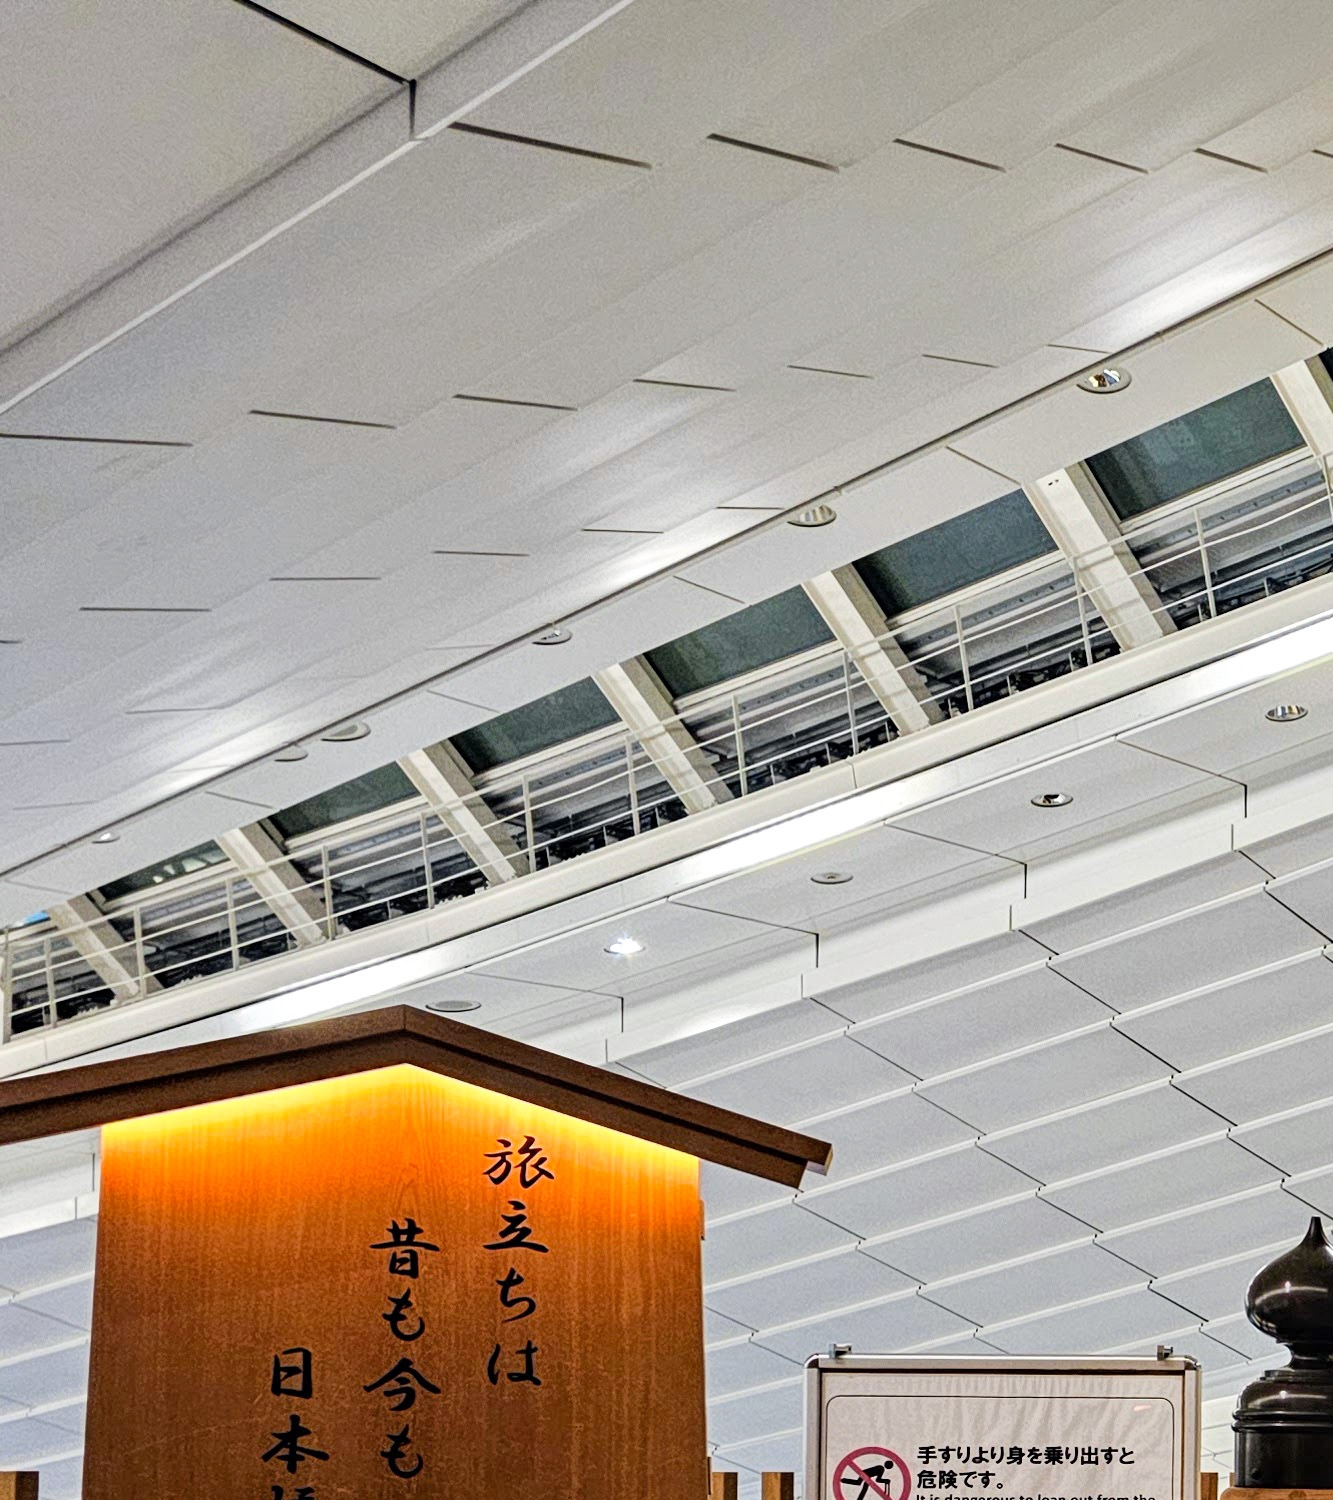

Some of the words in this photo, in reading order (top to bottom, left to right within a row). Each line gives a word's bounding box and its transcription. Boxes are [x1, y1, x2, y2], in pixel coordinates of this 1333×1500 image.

[363, 1217, 442, 1479] 昔も今も
[482, 1134, 556, 1388] 旅立ちは
[916, 1469, 1004, 1490] 危険です。
